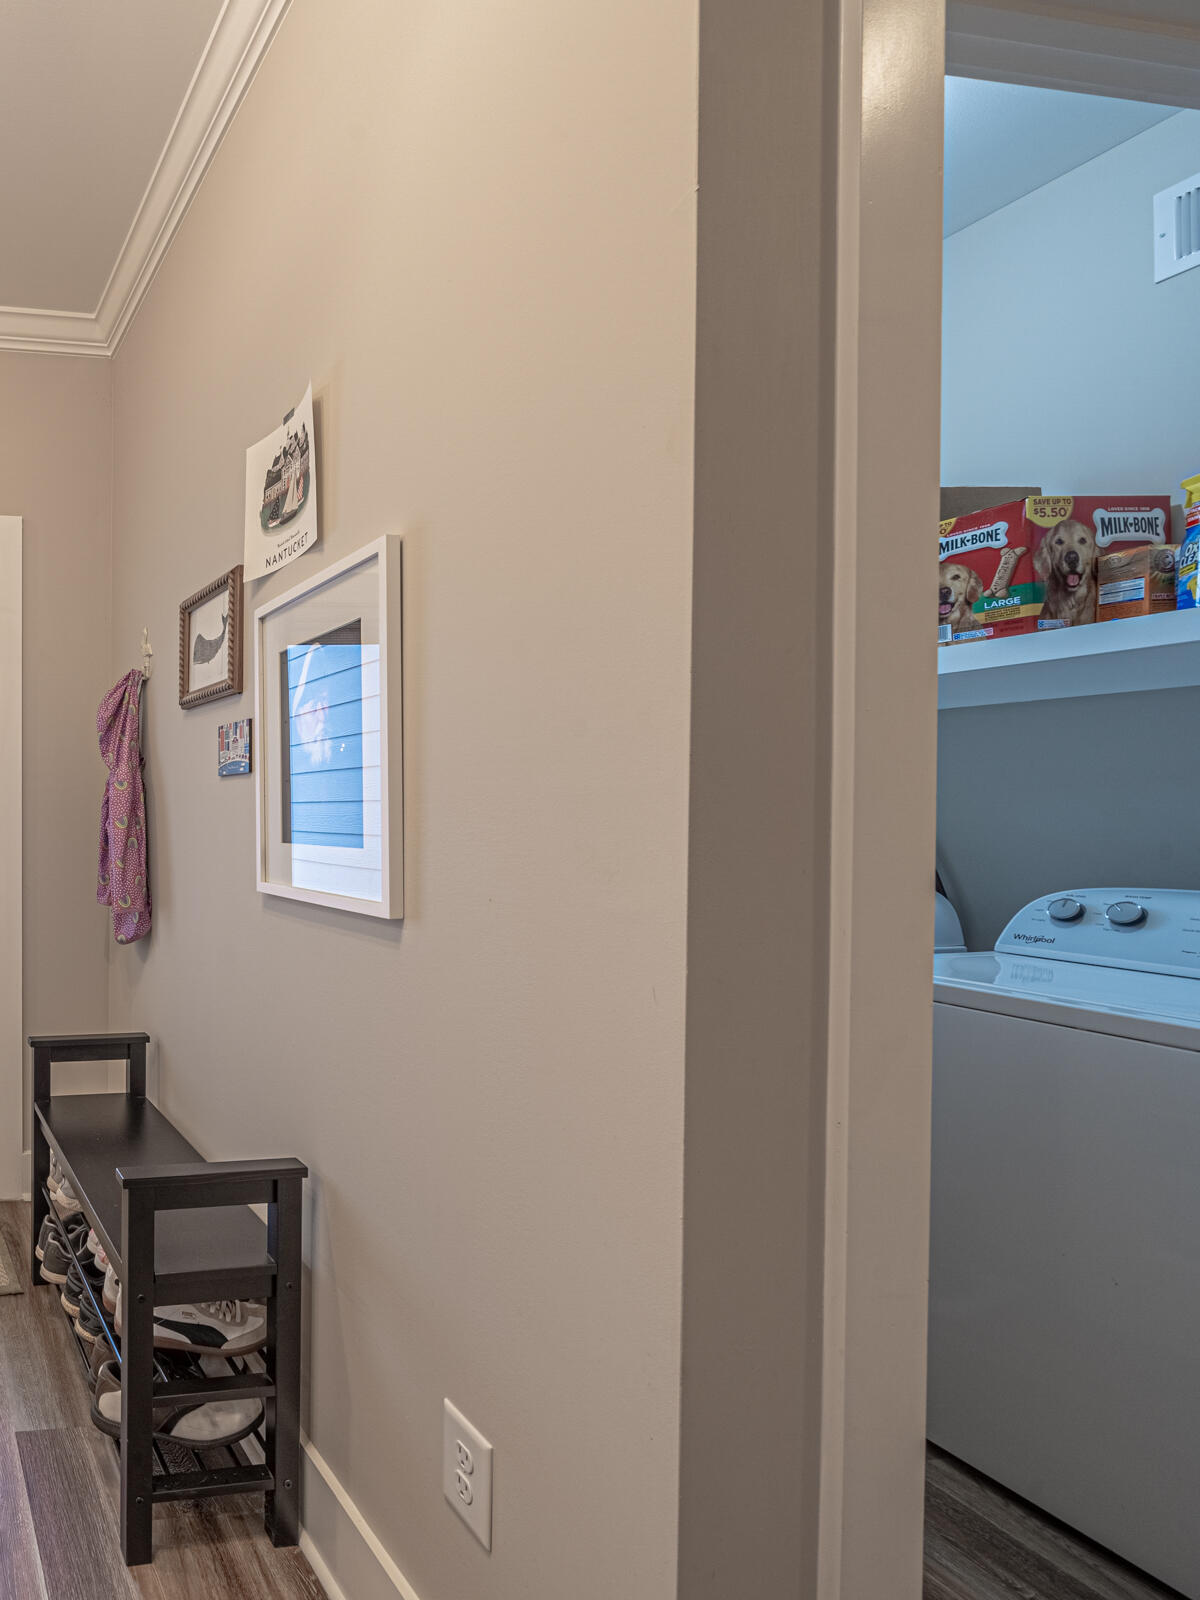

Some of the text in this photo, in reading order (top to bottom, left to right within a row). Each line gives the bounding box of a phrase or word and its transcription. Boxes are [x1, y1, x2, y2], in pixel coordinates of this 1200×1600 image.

[1033, 507, 1068, 518] $5.50
[265, 531, 309, 568] NANTUCKET
[984, 596, 1021, 610] LARGE
[1013, 933, 1056, 944] Whirlpool
